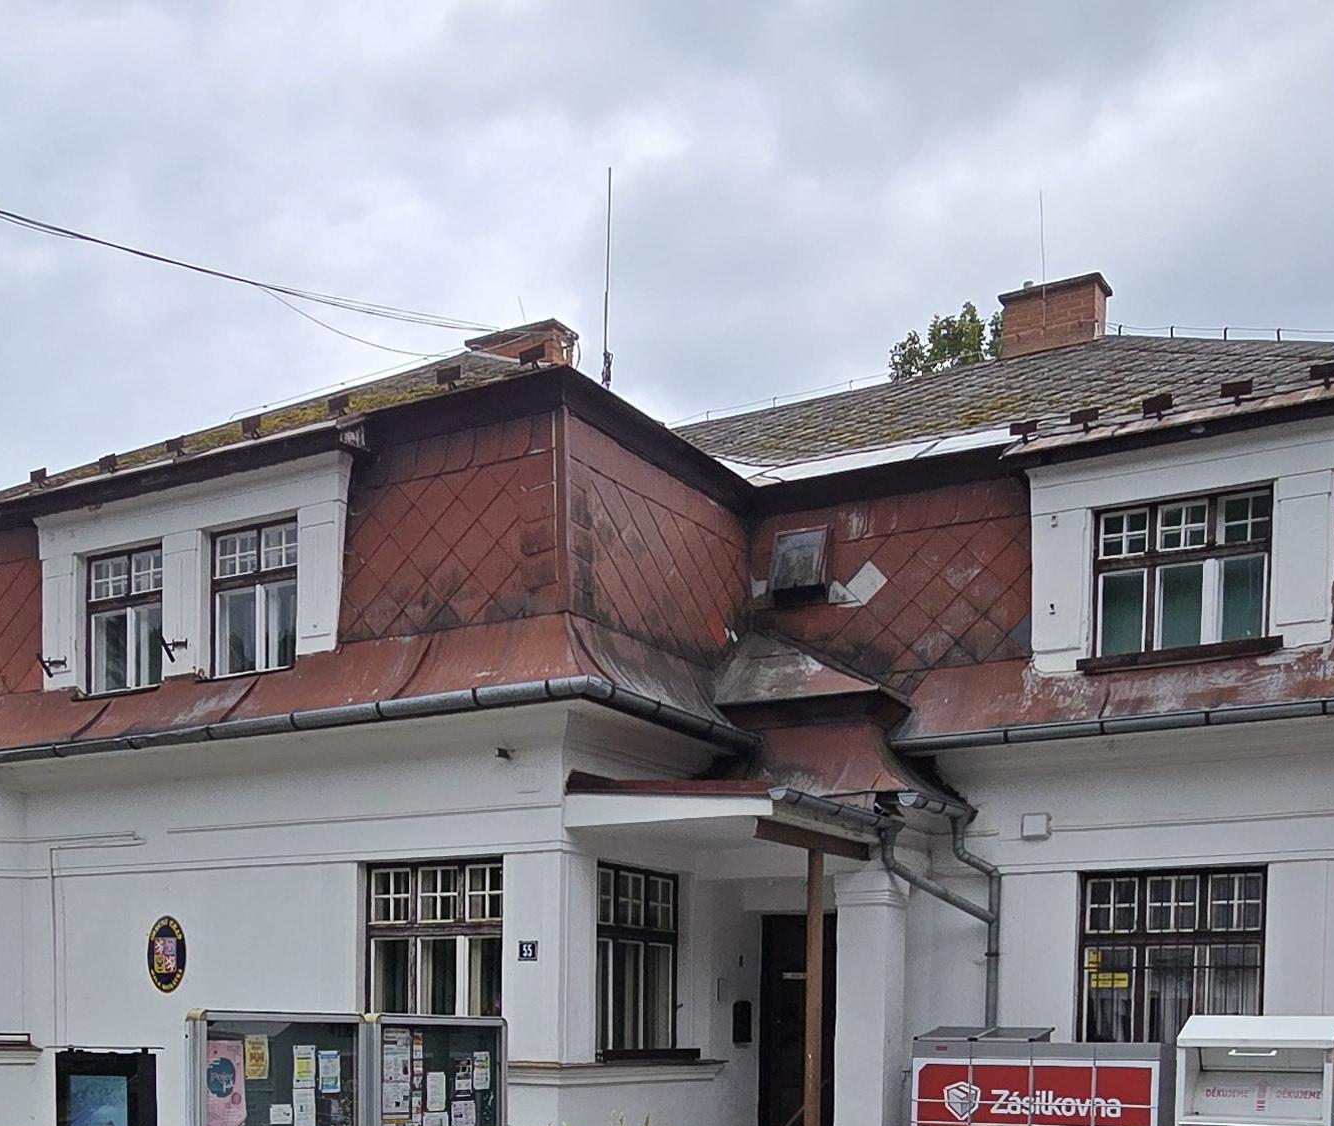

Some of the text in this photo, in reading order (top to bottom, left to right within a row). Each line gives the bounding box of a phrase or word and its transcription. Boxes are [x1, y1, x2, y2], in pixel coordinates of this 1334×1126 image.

[522, 944, 533, 957] 55
[1205, 1087, 1250, 1099] DĚKUJEME
[1275, 1088, 1322, 1100] DĚKUJEME
[990, 1089, 1123, 1118] Zásilkovna
